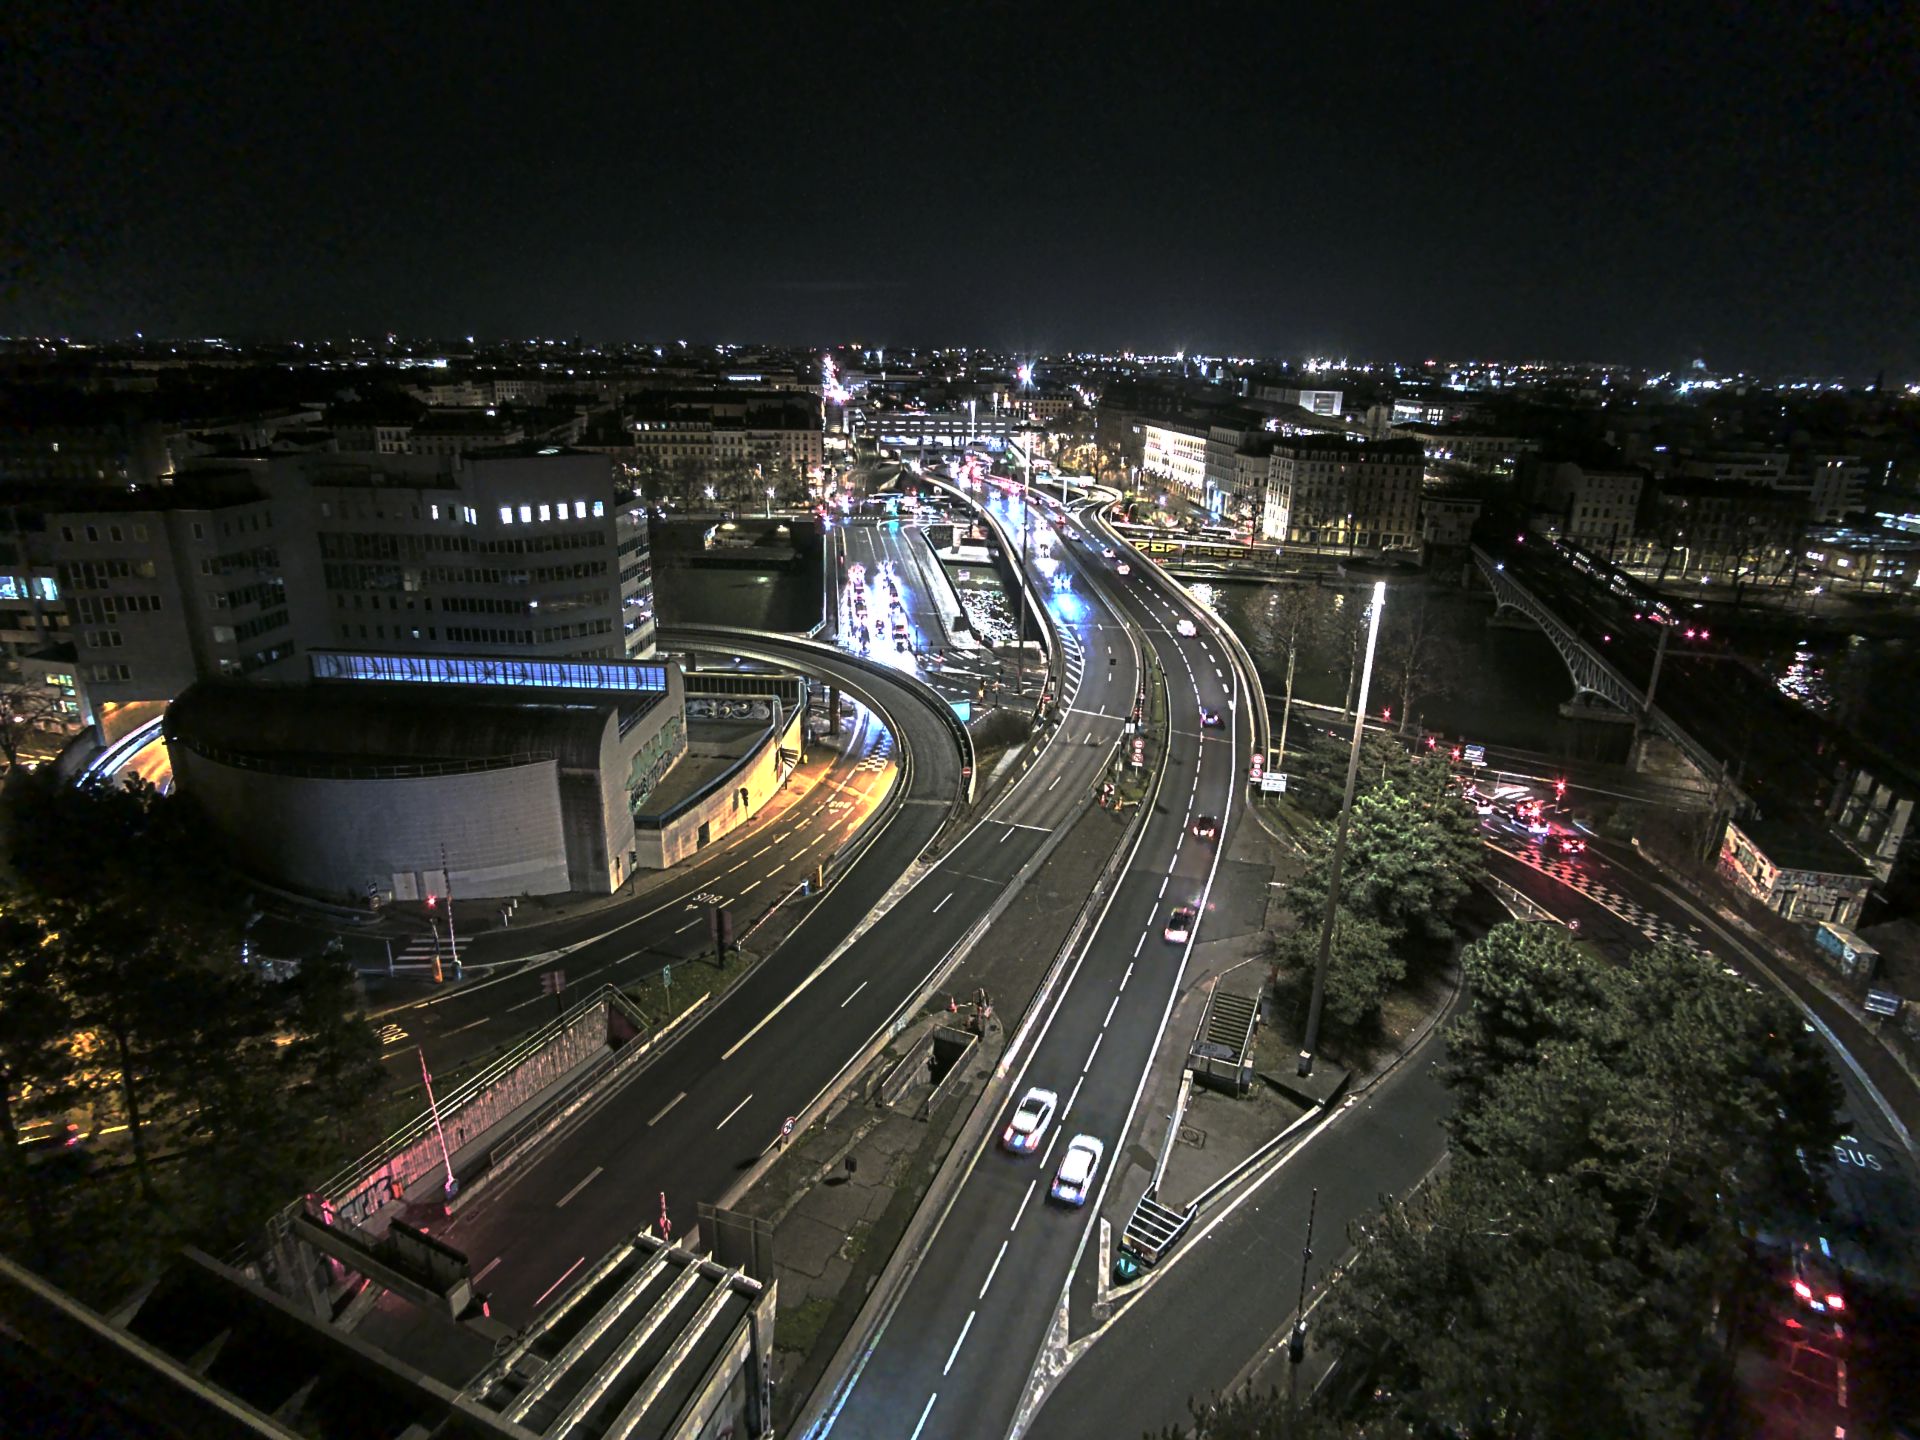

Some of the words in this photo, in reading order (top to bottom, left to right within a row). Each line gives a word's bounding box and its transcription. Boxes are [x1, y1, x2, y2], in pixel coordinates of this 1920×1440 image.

[692, 892, 724, 904] BUS
[381, 1023, 409, 1045] BUS
[1832, 1144, 1883, 1172] BUS
